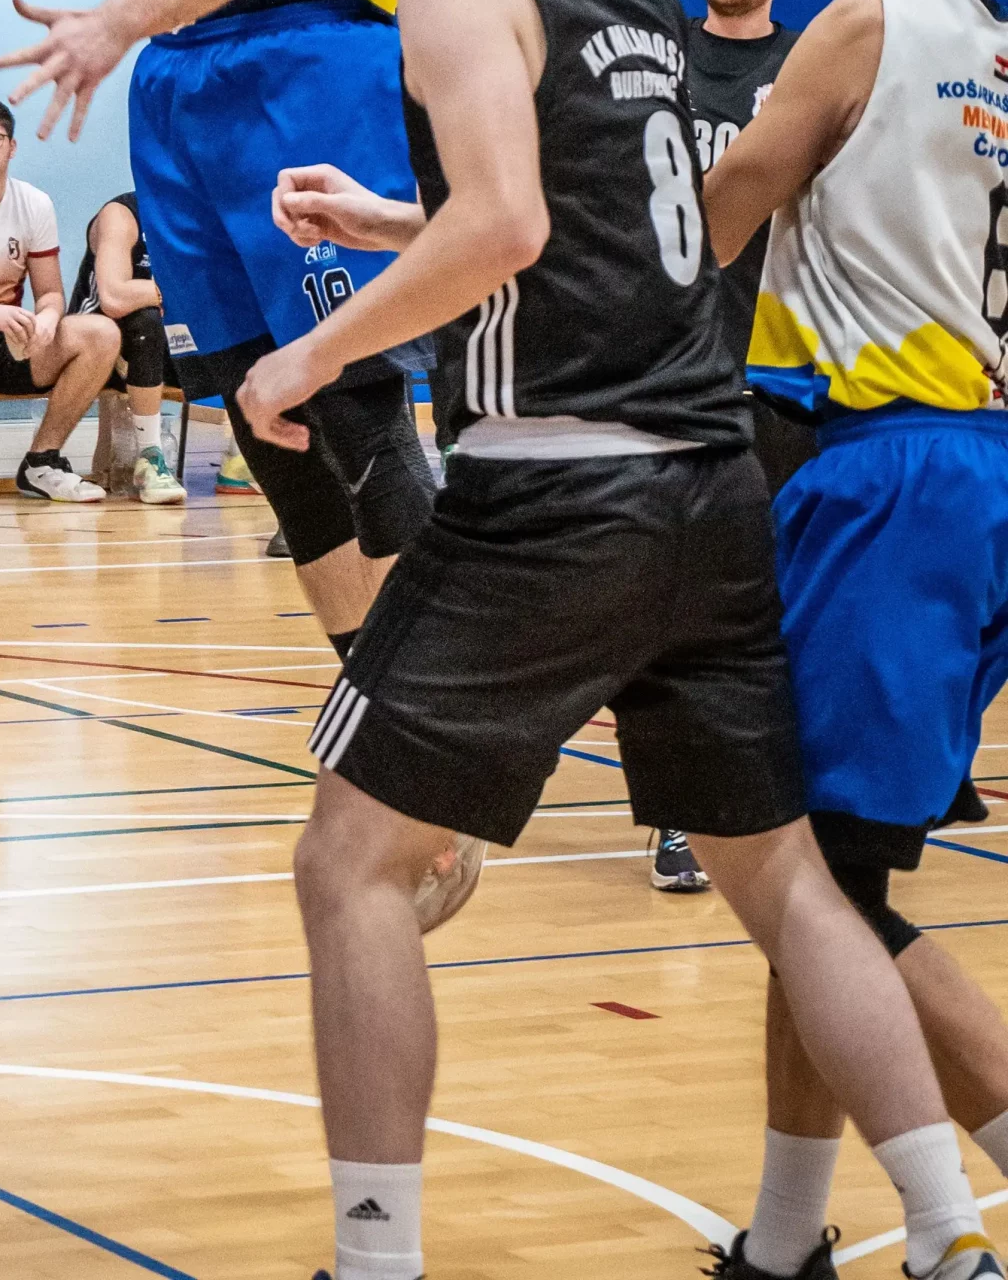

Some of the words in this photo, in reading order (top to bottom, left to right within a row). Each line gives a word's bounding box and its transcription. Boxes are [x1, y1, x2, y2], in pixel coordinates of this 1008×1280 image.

[580, 29, 616, 78] KK
[693, 119, 740, 173] 30
[644, 110, 704, 287] 8
